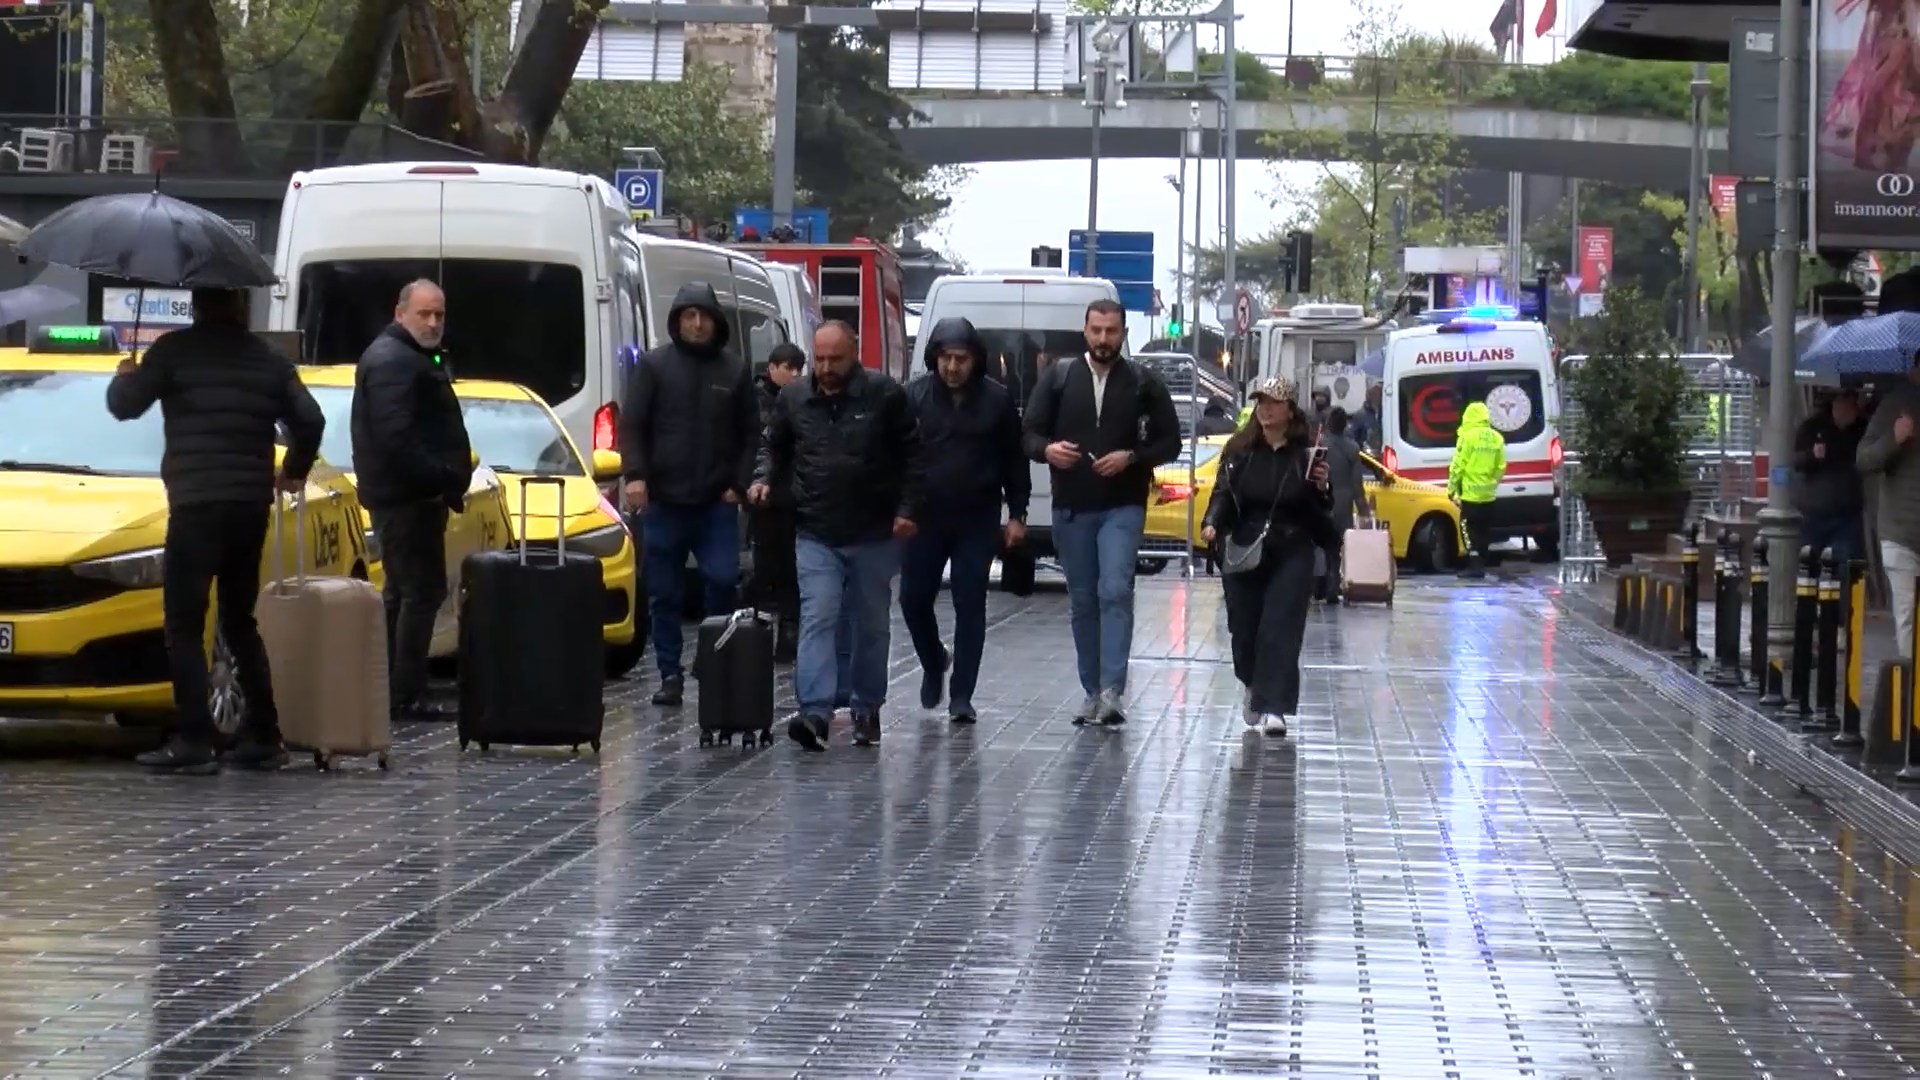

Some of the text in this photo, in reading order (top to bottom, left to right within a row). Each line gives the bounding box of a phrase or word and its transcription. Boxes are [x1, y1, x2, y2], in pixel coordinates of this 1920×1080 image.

[631, 183, 646, 200] P
[1834, 201, 1920, 217] imannoor.
[1416, 347, 1515, 365] AMBULANS
[311, 512, 339, 570] Uber
